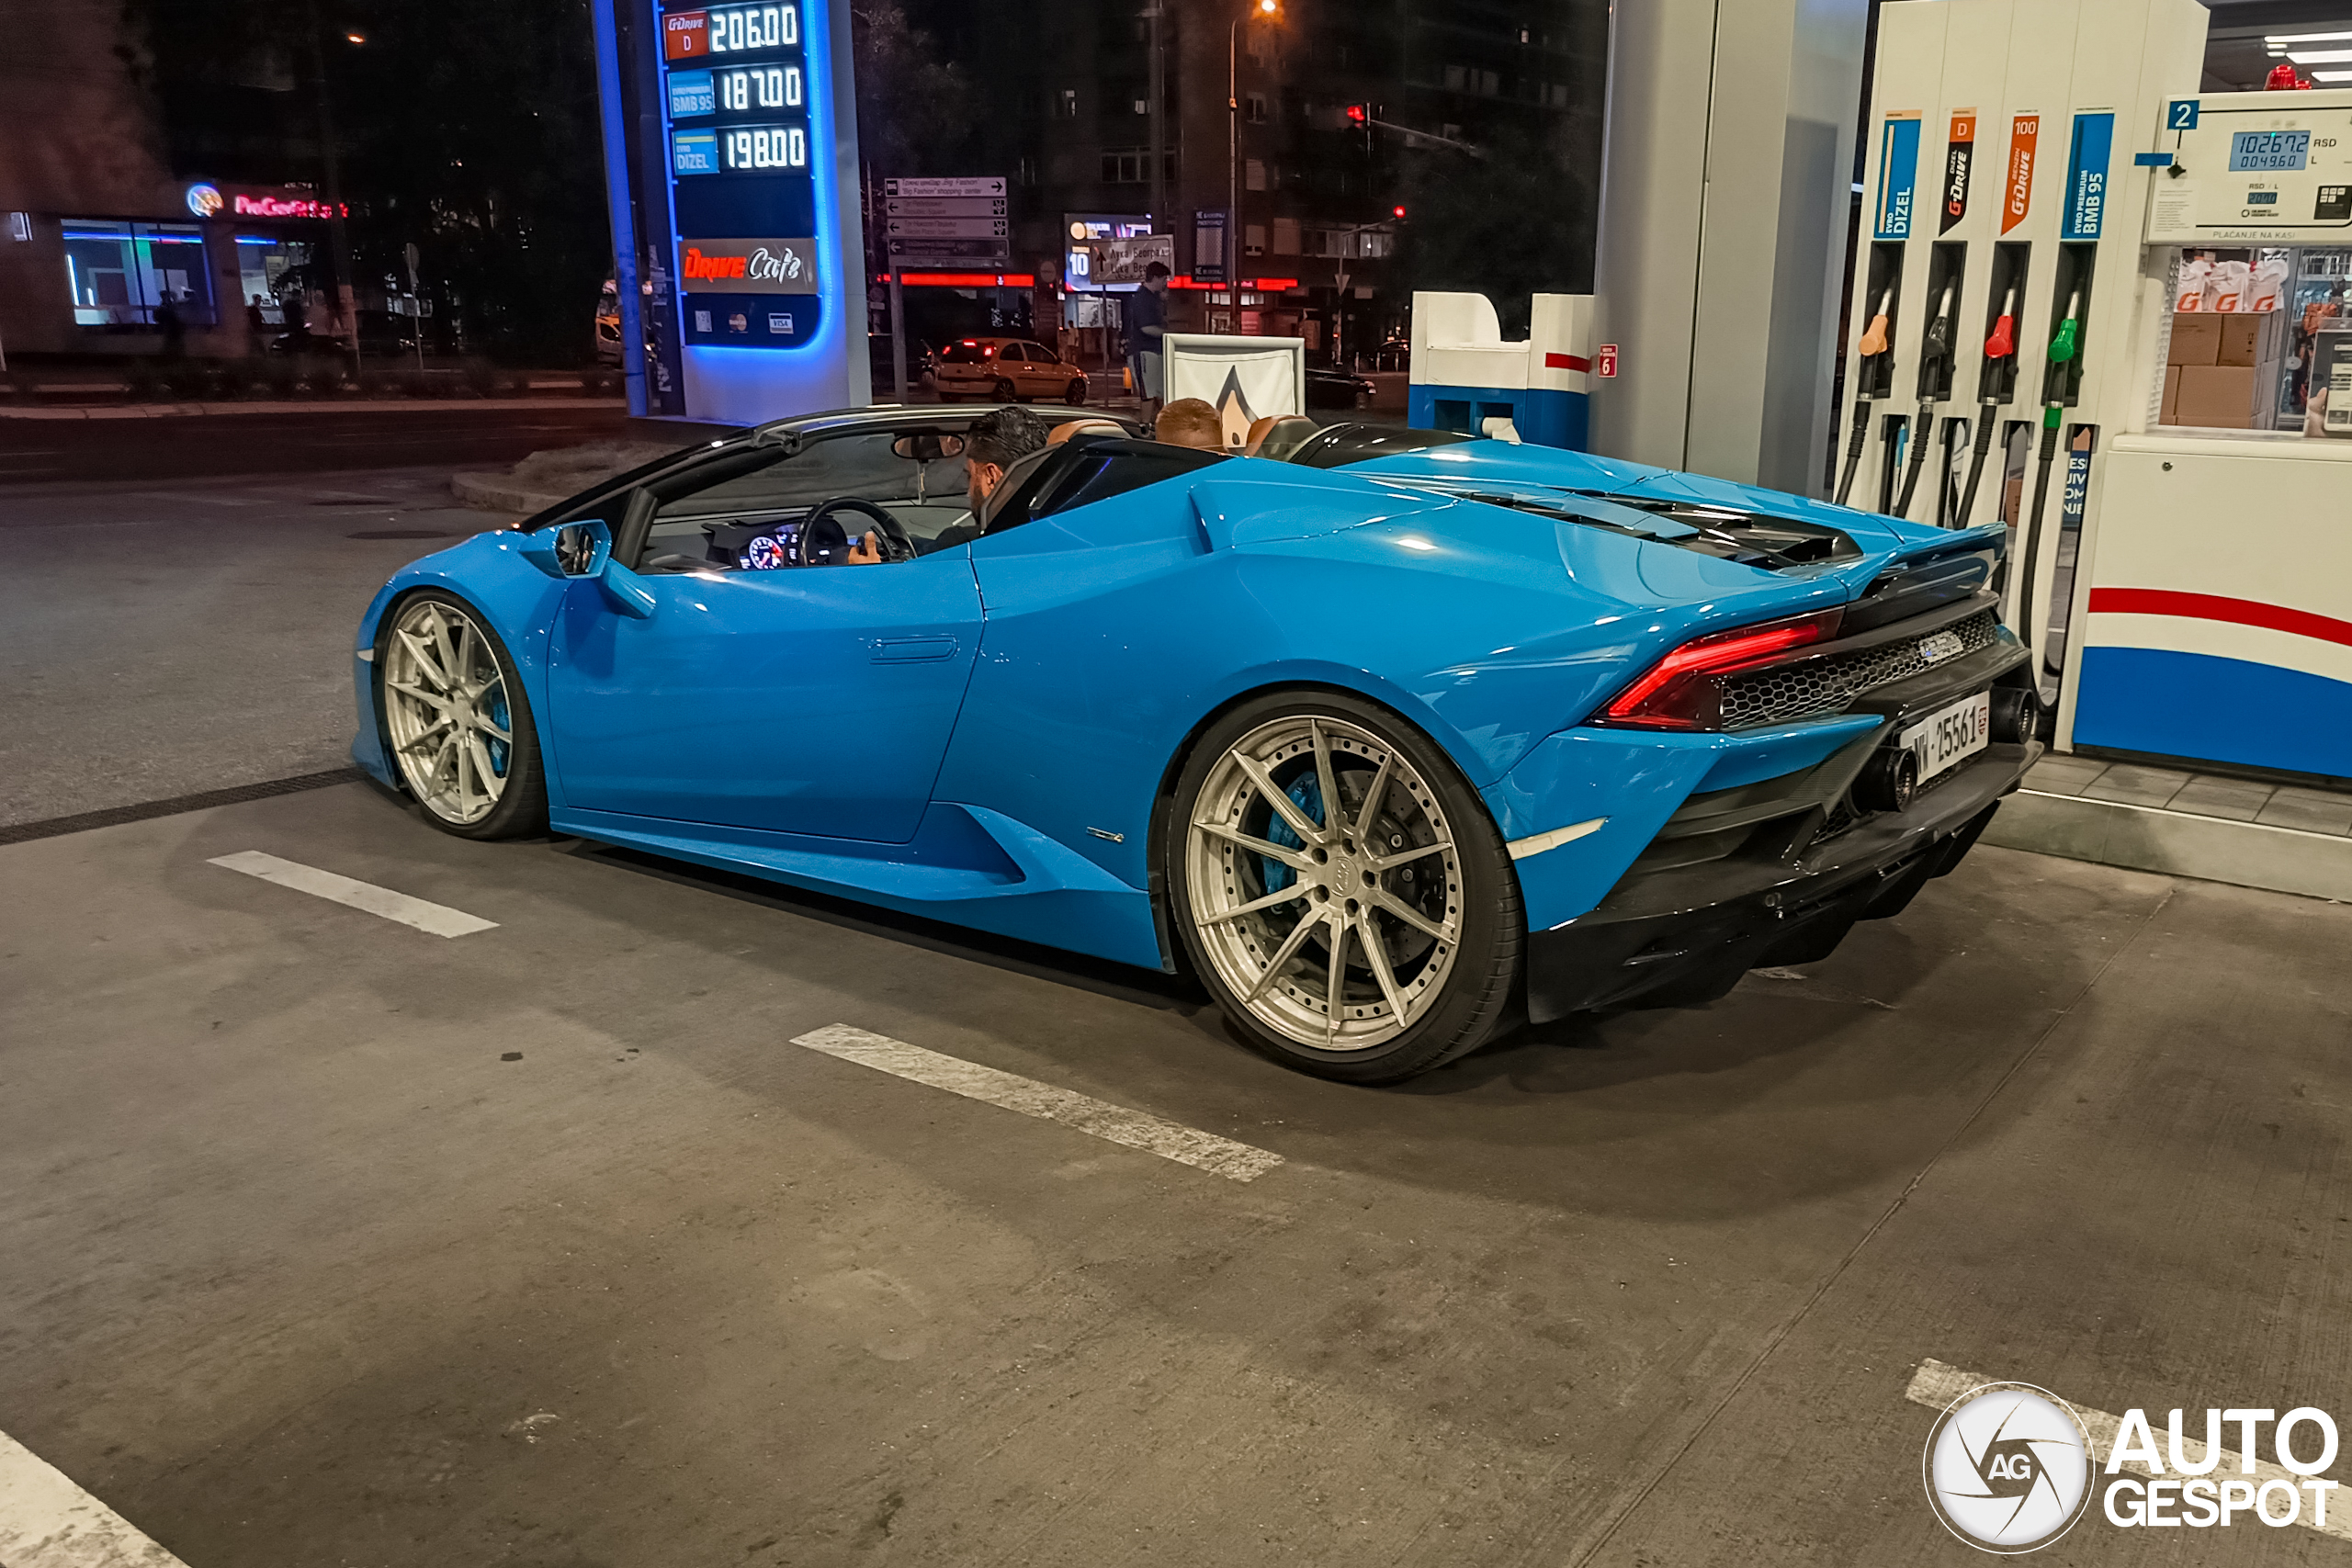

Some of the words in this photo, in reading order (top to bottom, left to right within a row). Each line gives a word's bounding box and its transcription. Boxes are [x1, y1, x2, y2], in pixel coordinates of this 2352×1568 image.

[683, 35, 692, 51] D
[673, 96, 698, 112] BMB
[698, 95, 712, 110] 95
[2175, 103, 2192, 128] 2
[1957, 121, 1967, 137] D
[2015, 121, 2037, 136] 100
[2313, 139, 2337, 148] RSD
[677, 153, 709, 170] DIZEL
[1949, 149, 1958, 175] DIZEL
[2011, 147, 2020, 181] BENZIN
[2311, 156, 2317, 164] L
[2075, 169, 2088, 211] PREMIJUM
[2088, 172, 2103, 194] 95
[1894, 186, 1912, 234] DIZEL
[2082, 196, 2099, 234] BMB
[1885, 212, 1894, 234] EVRO
[2074, 210, 2082, 234] EVRO
[684, 247, 747, 283] DRIVE
[1069, 254, 1090, 276] 10
[1111, 249, 1129, 259] Лука
[1111, 263, 1129, 274] Luka
[1602, 358, 1611, 375] 6
[1937, 705, 1977, 762] 25561
